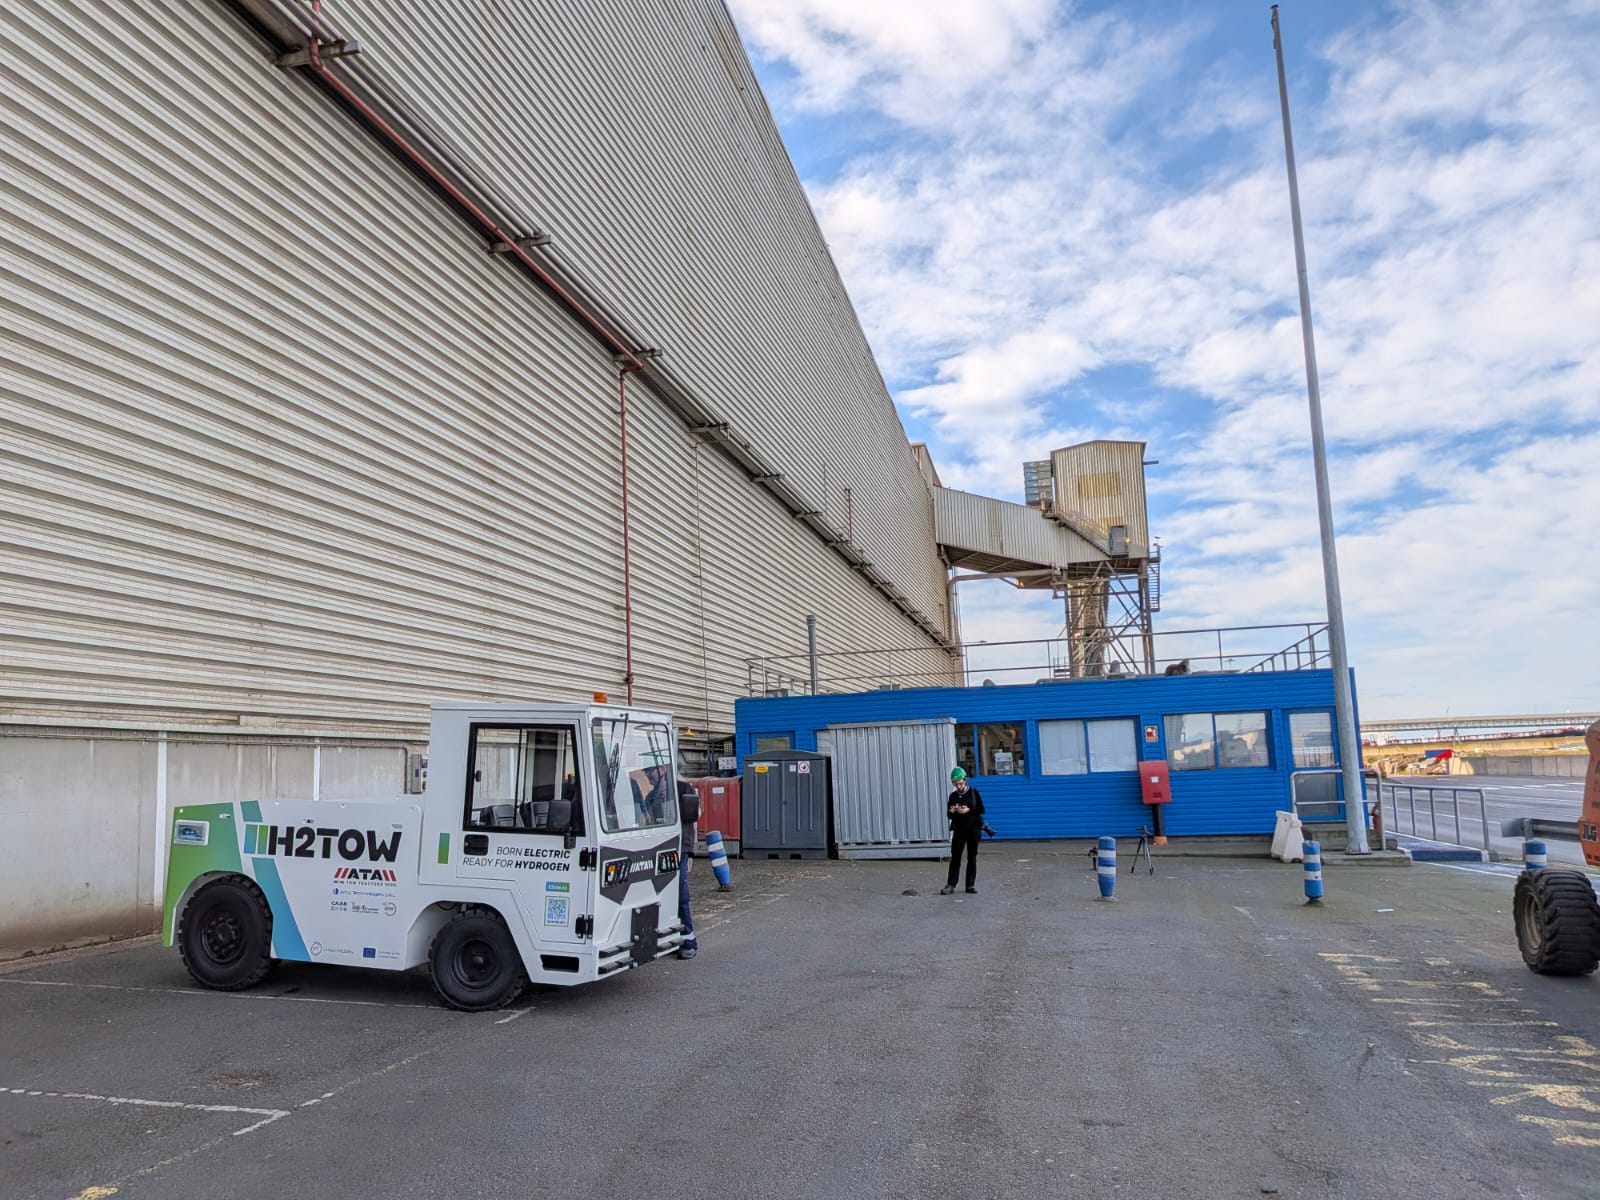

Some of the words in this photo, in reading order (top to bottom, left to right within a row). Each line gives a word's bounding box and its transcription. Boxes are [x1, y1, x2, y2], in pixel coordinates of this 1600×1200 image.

[1583, 824, 1598, 841] JLG
[268, 825, 403, 863] H2TOW
[496, 846, 523, 856] BORN
[524, 848, 571, 859] ELECTRIC
[463, 857, 494, 867] READY
[494, 858, 514, 868] FOR
[514, 860, 570, 871] HYDROGEN
